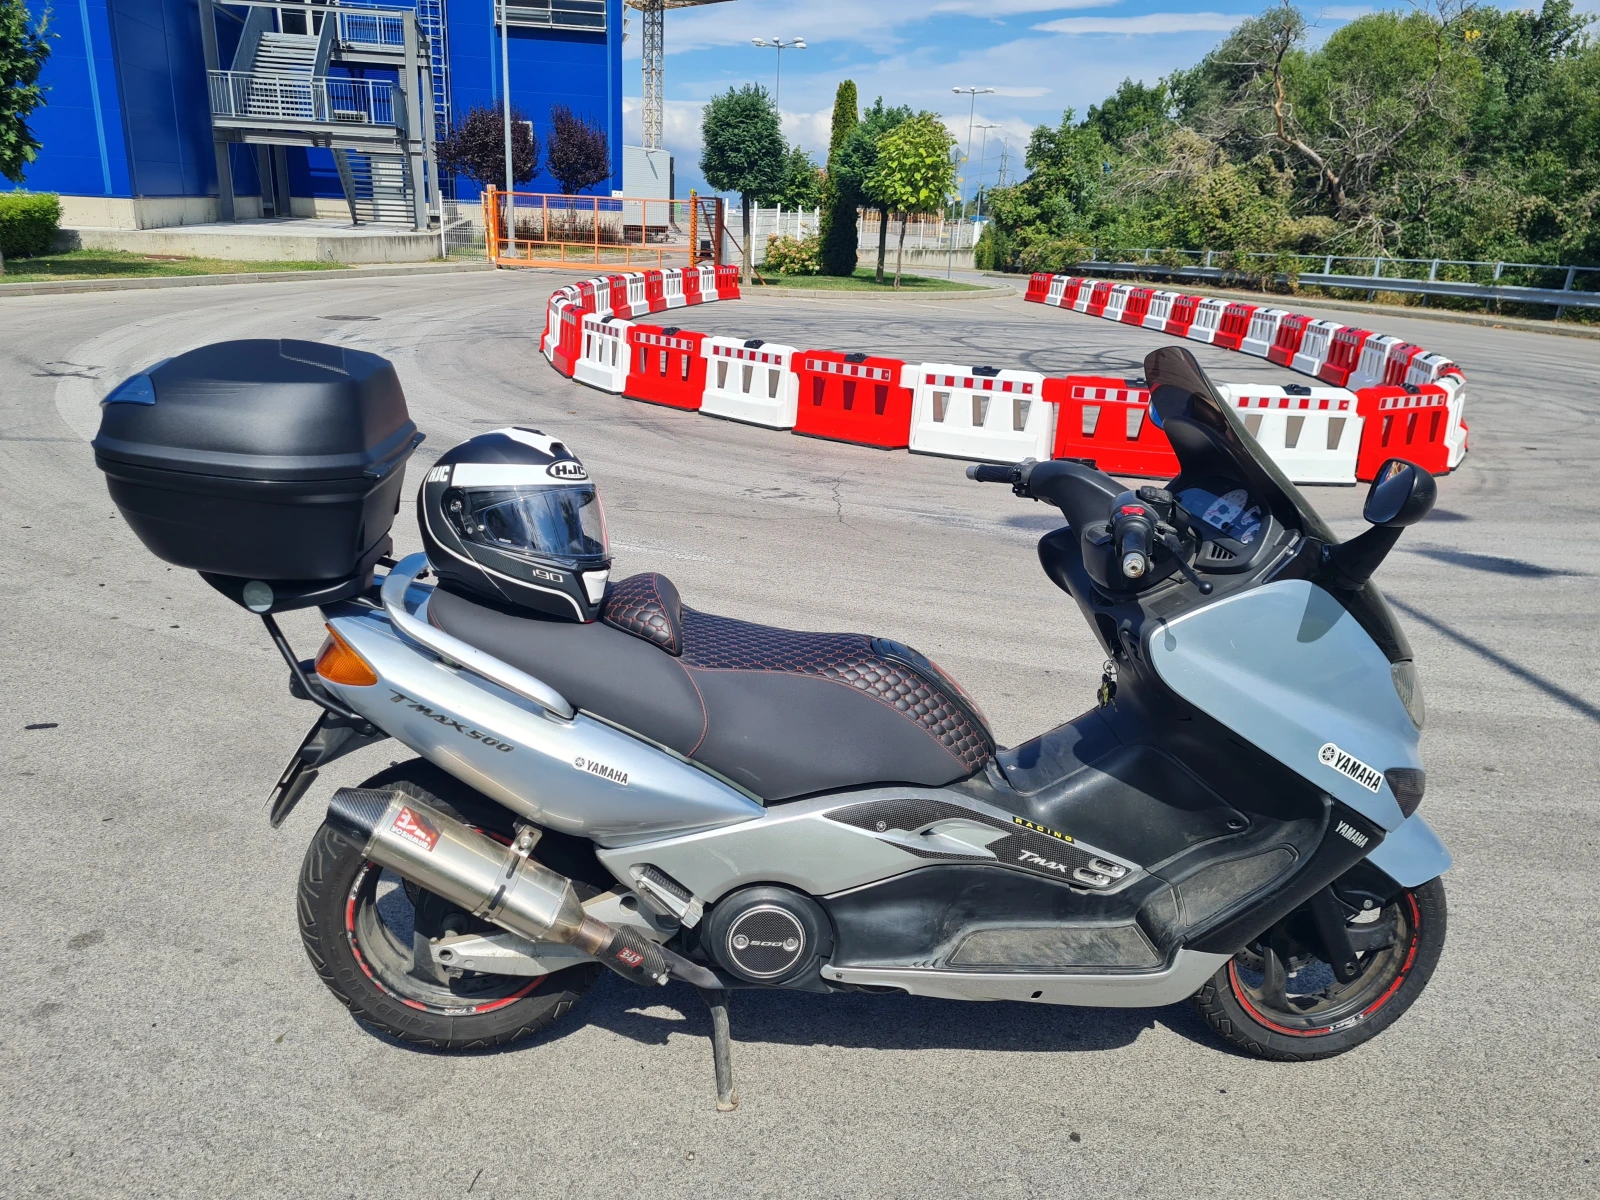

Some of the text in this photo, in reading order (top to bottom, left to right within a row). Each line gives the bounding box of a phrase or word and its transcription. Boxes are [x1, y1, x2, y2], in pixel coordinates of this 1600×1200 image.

[427, 465, 450, 482] HJC
[555, 464, 586, 475] HJC
[586, 759, 629, 784] YAMAHA
[1334, 752, 1382, 791] YAMAHA
[1014, 817, 1073, 842] RACING
[1335, 820, 1369, 849] YAMAHA
